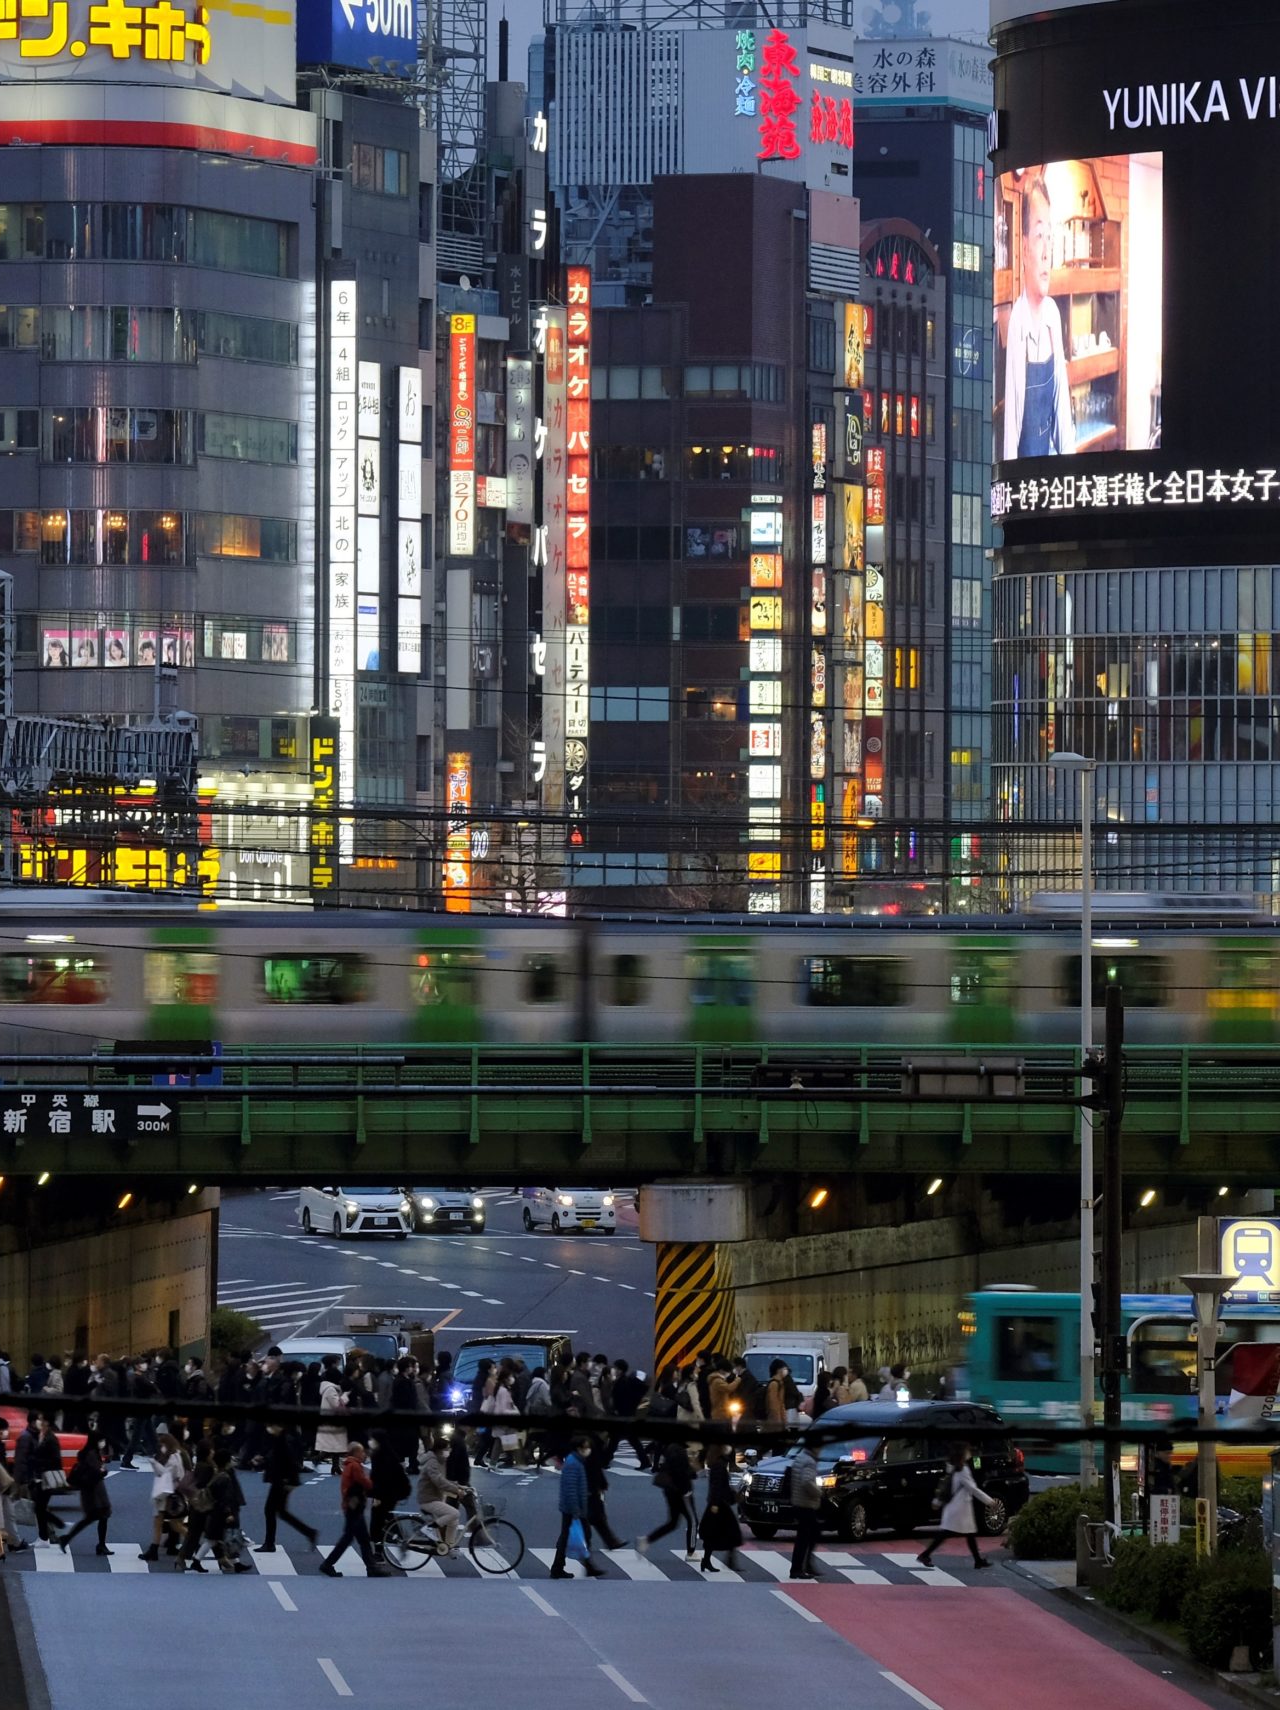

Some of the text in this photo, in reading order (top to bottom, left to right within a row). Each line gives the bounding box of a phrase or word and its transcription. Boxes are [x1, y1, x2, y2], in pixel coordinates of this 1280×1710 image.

[873, 46, 937, 70] 水の森
[758, 28, 803, 160] 東海苑
[1102, 75, 1280, 131] YUNIKA VI
[454, 317, 472, 331] 8F
[568, 283, 589, 539] カラオケパセラ
[335, 515, 351, 609] 北の家族
[3, 1109, 116, 1133] 新宿駅
[137, 1121, 170, 1132] 300M
